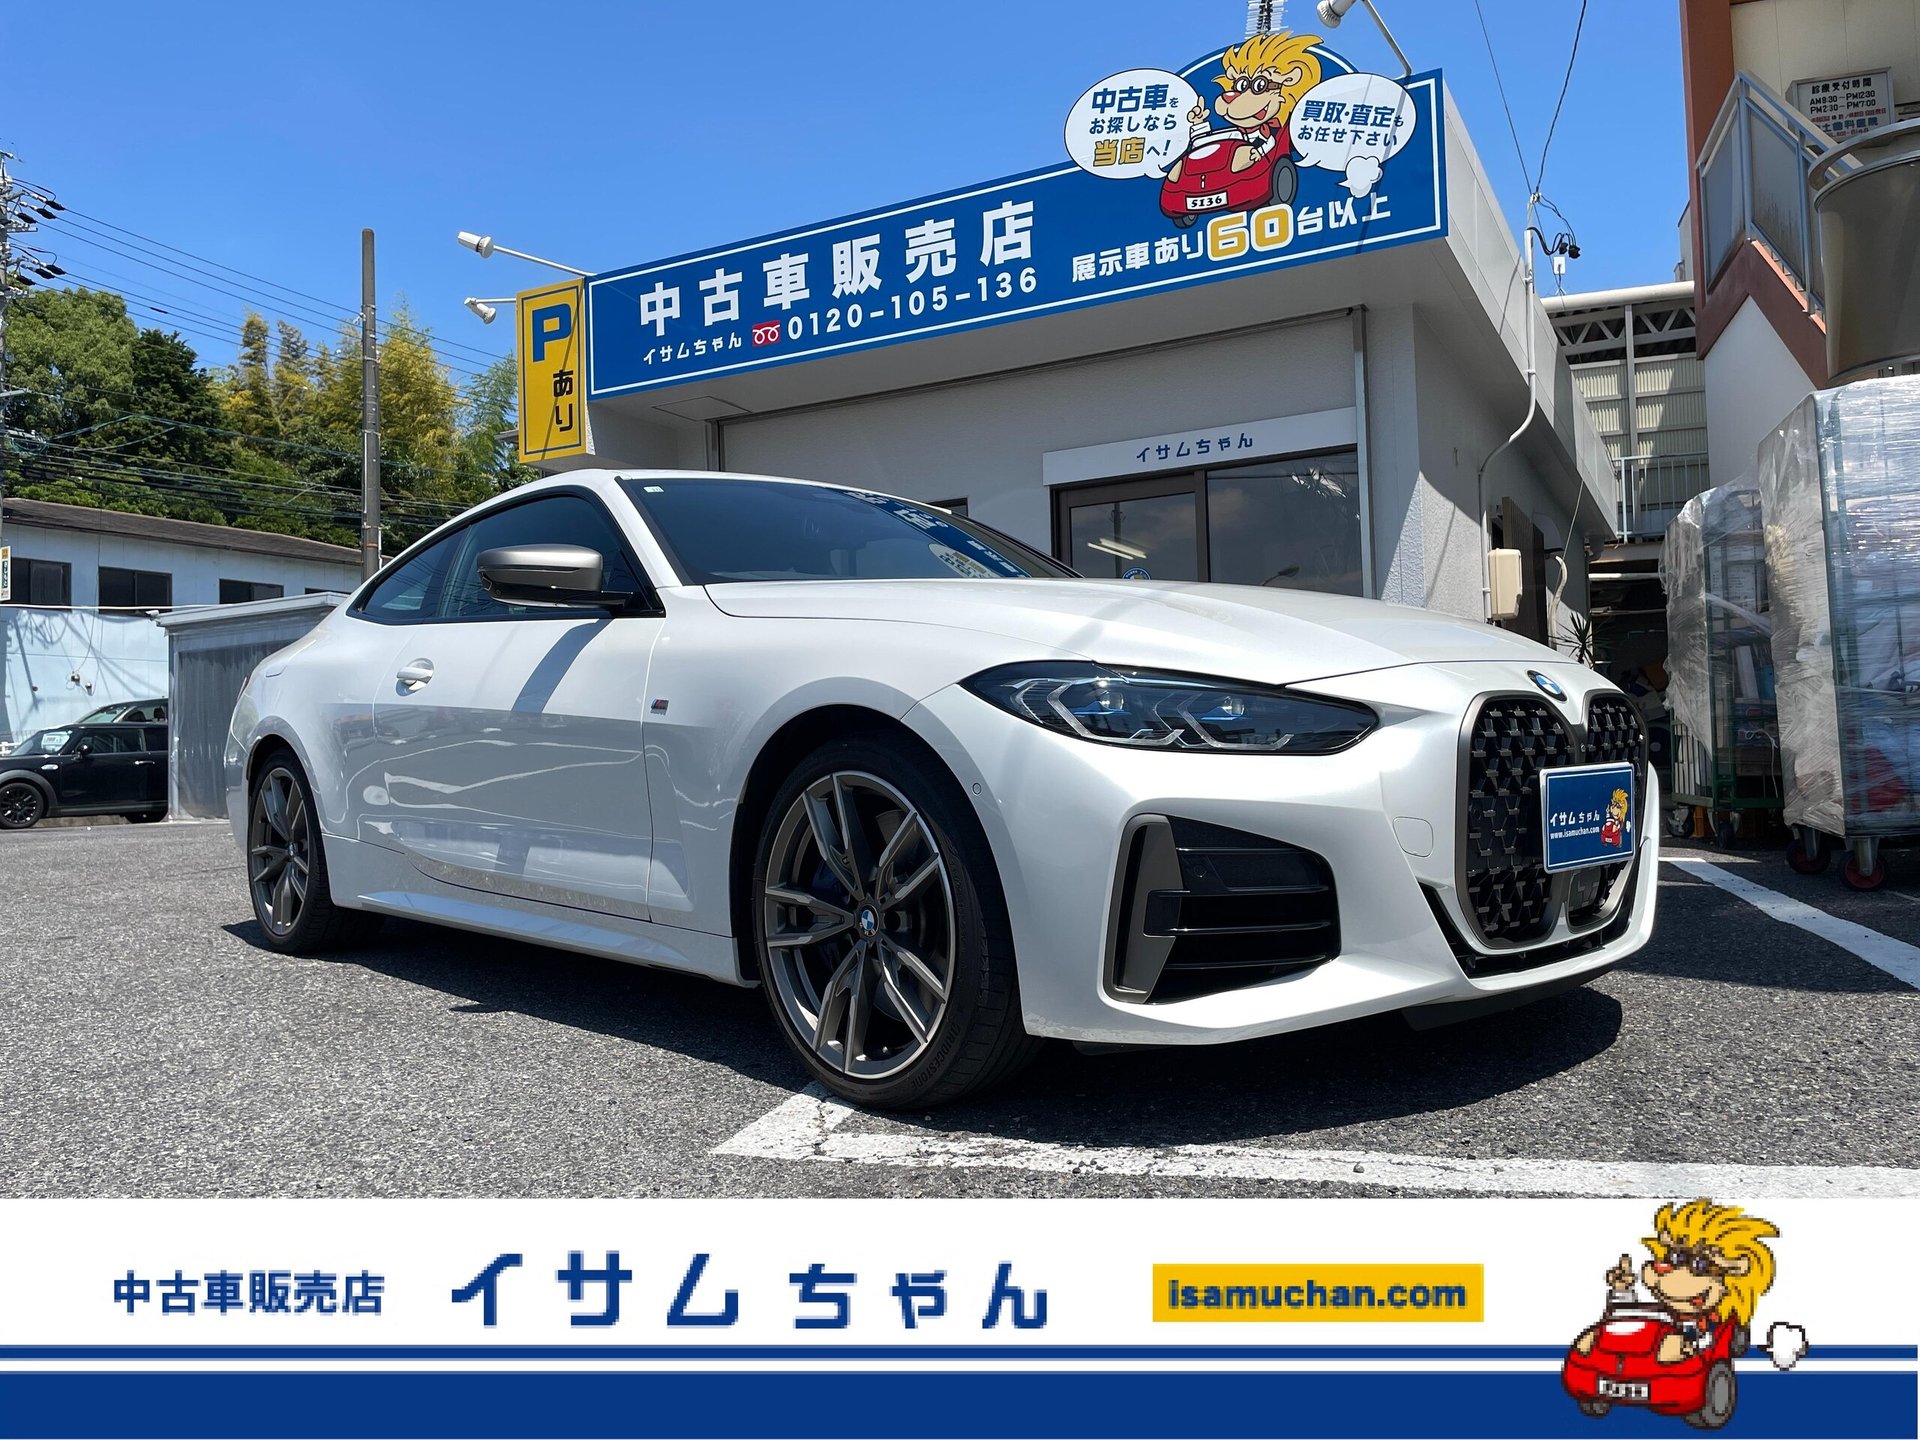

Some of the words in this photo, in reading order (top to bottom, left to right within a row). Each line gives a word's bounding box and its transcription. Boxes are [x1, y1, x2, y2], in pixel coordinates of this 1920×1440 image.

[1091, 84, 1179, 114] 中古車を
[1089, 114, 1177, 136] お探しなら
[1297, 125, 1397, 148] お任せ下さい
[1191, 195, 1223, 208] 5136
[640, 200, 1035, 337] 中古車販売店
[787, 268, 1038, 341] 0120-105-136
[643, 334, 742, 365] イサムちゃん
[532, 302, 572, 362] P
[552, 369, 574, 433] あり
[1136, 433, 1254, 463] イサムちゃん
[1550, 809, 1600, 827] イサムちゃん
[1550, 826, 1600, 840] www.isamuchan.com
